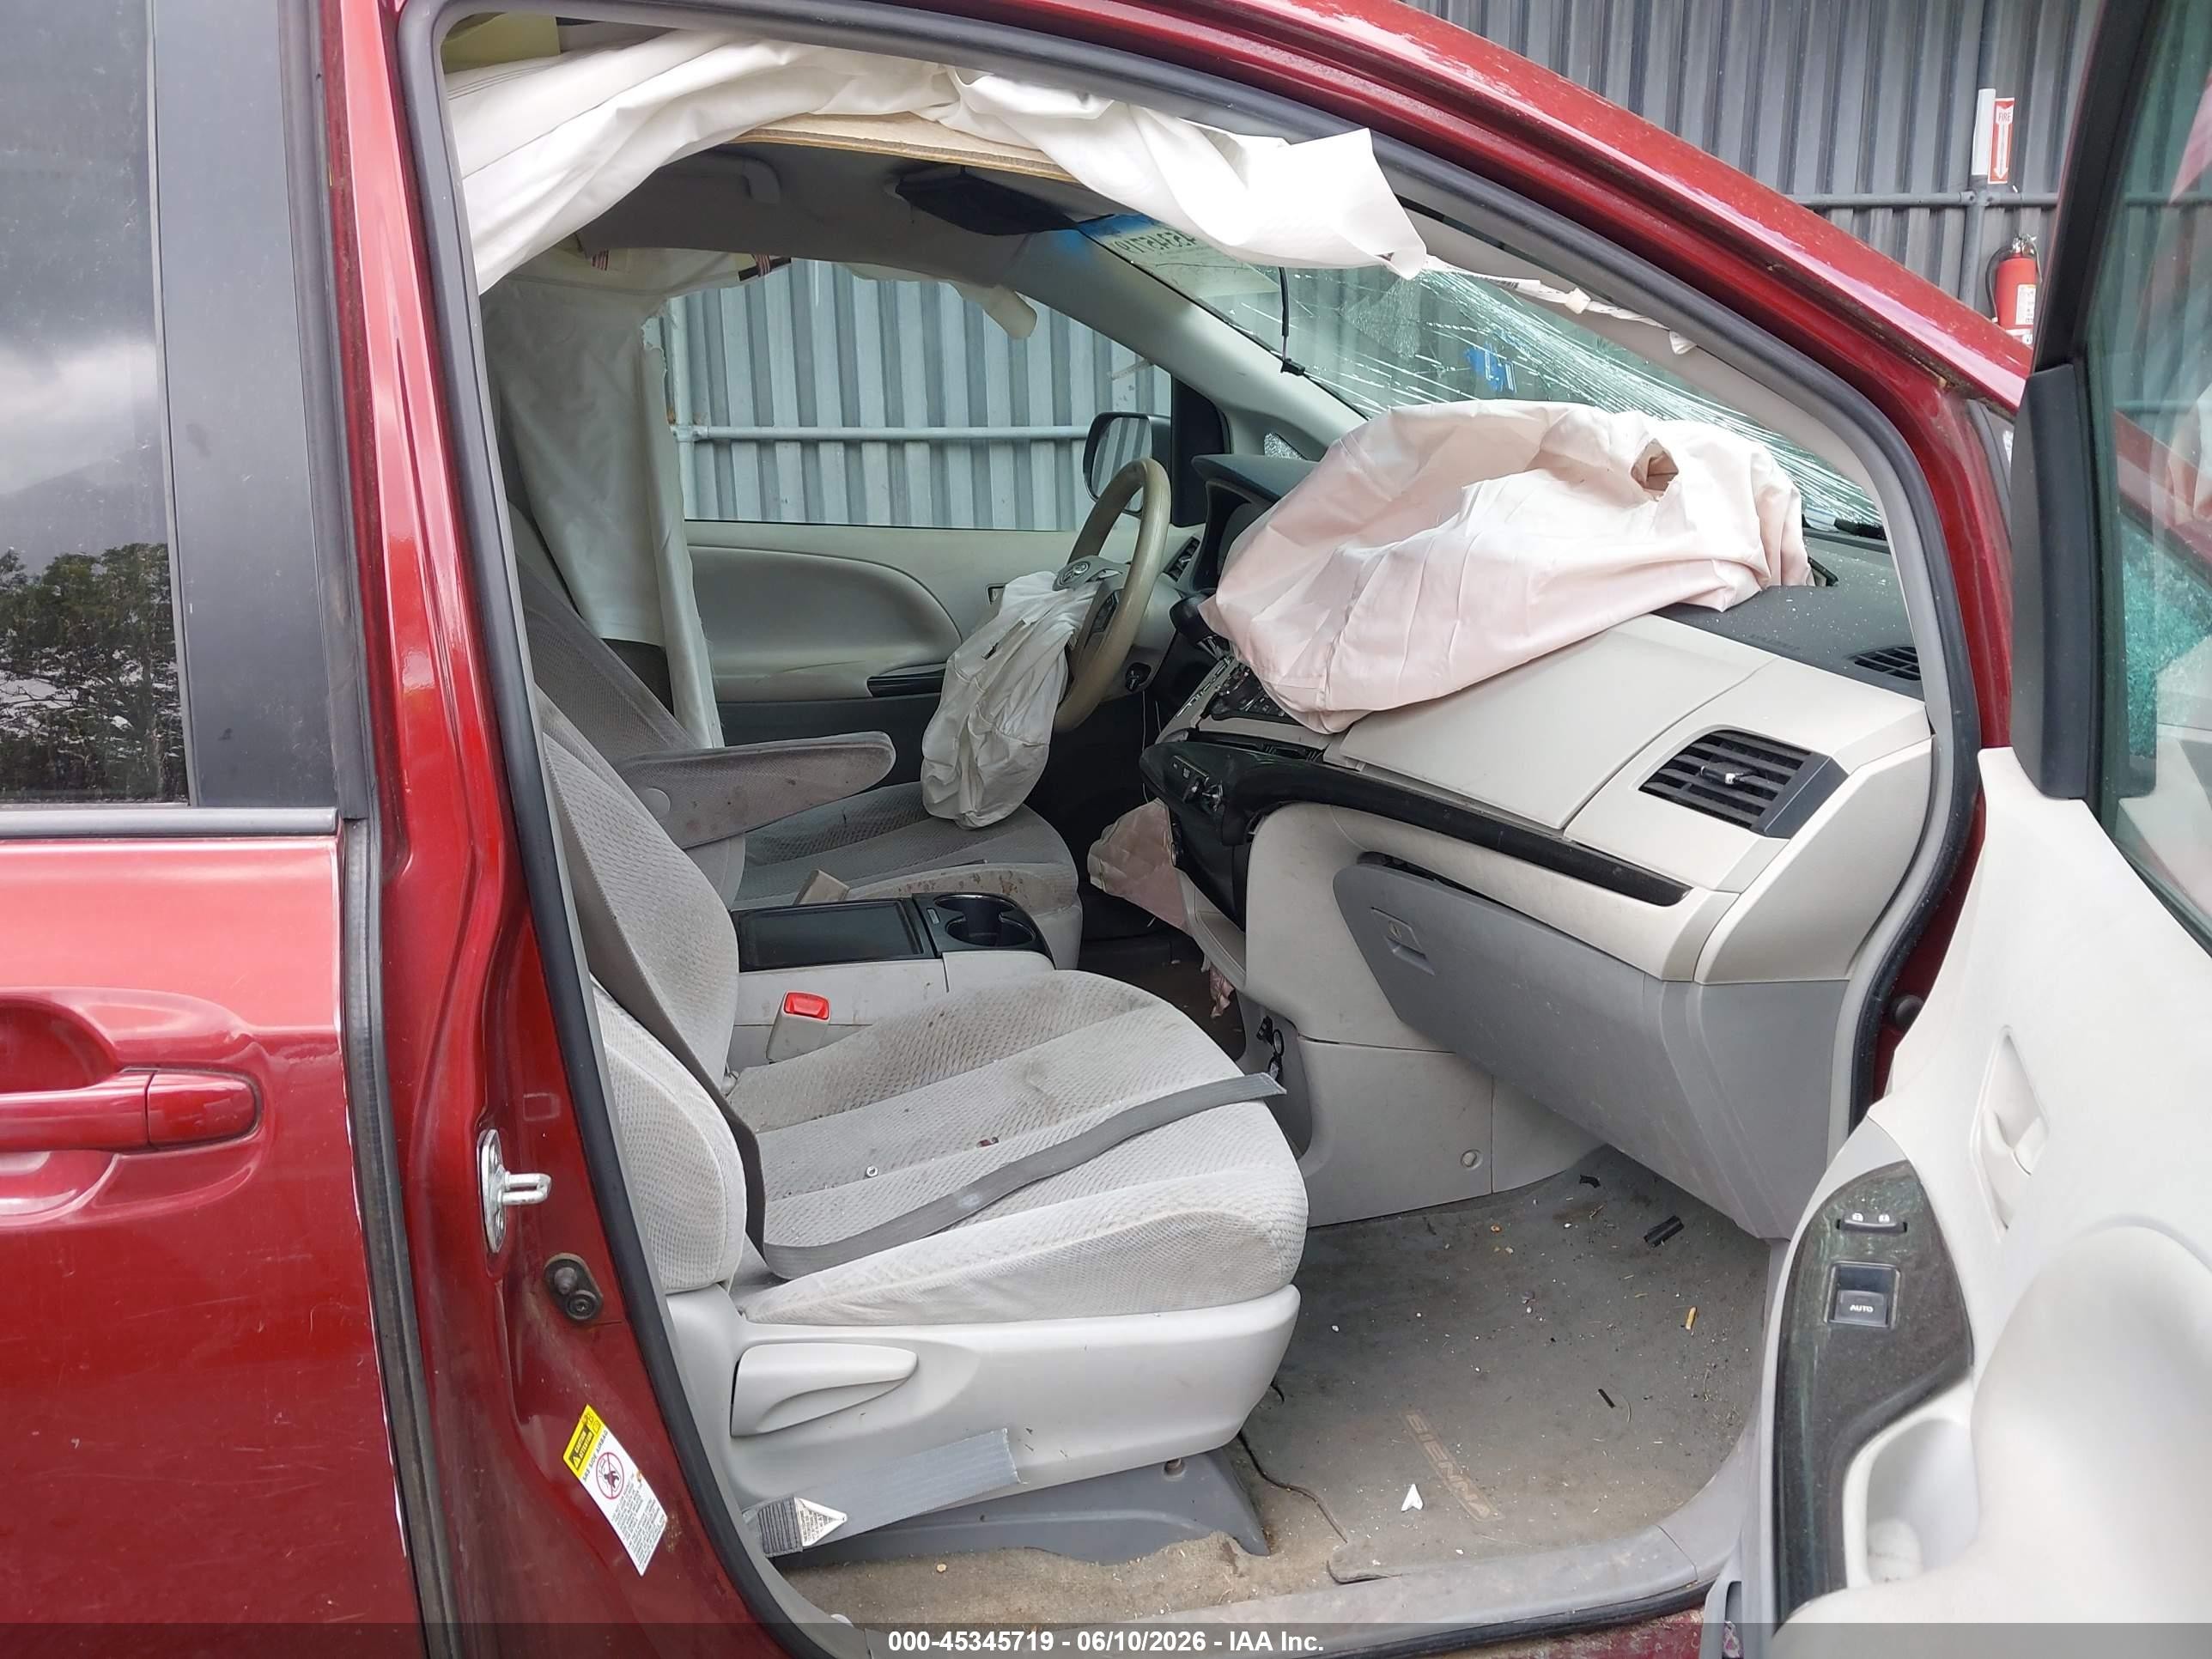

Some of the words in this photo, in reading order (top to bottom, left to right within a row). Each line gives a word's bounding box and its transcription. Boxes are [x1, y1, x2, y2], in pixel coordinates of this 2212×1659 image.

[1998, 112, 2011, 122] FIRE
[1850, 1304, 1874, 1313] AUTO
[574, 1430, 587, 1454] CAUTION
[578, 1431, 593, 1459] ATTENTION
[596, 1430, 609, 1454] AIRBAG
[1406, 1413, 1492, 1519] SIENNA
